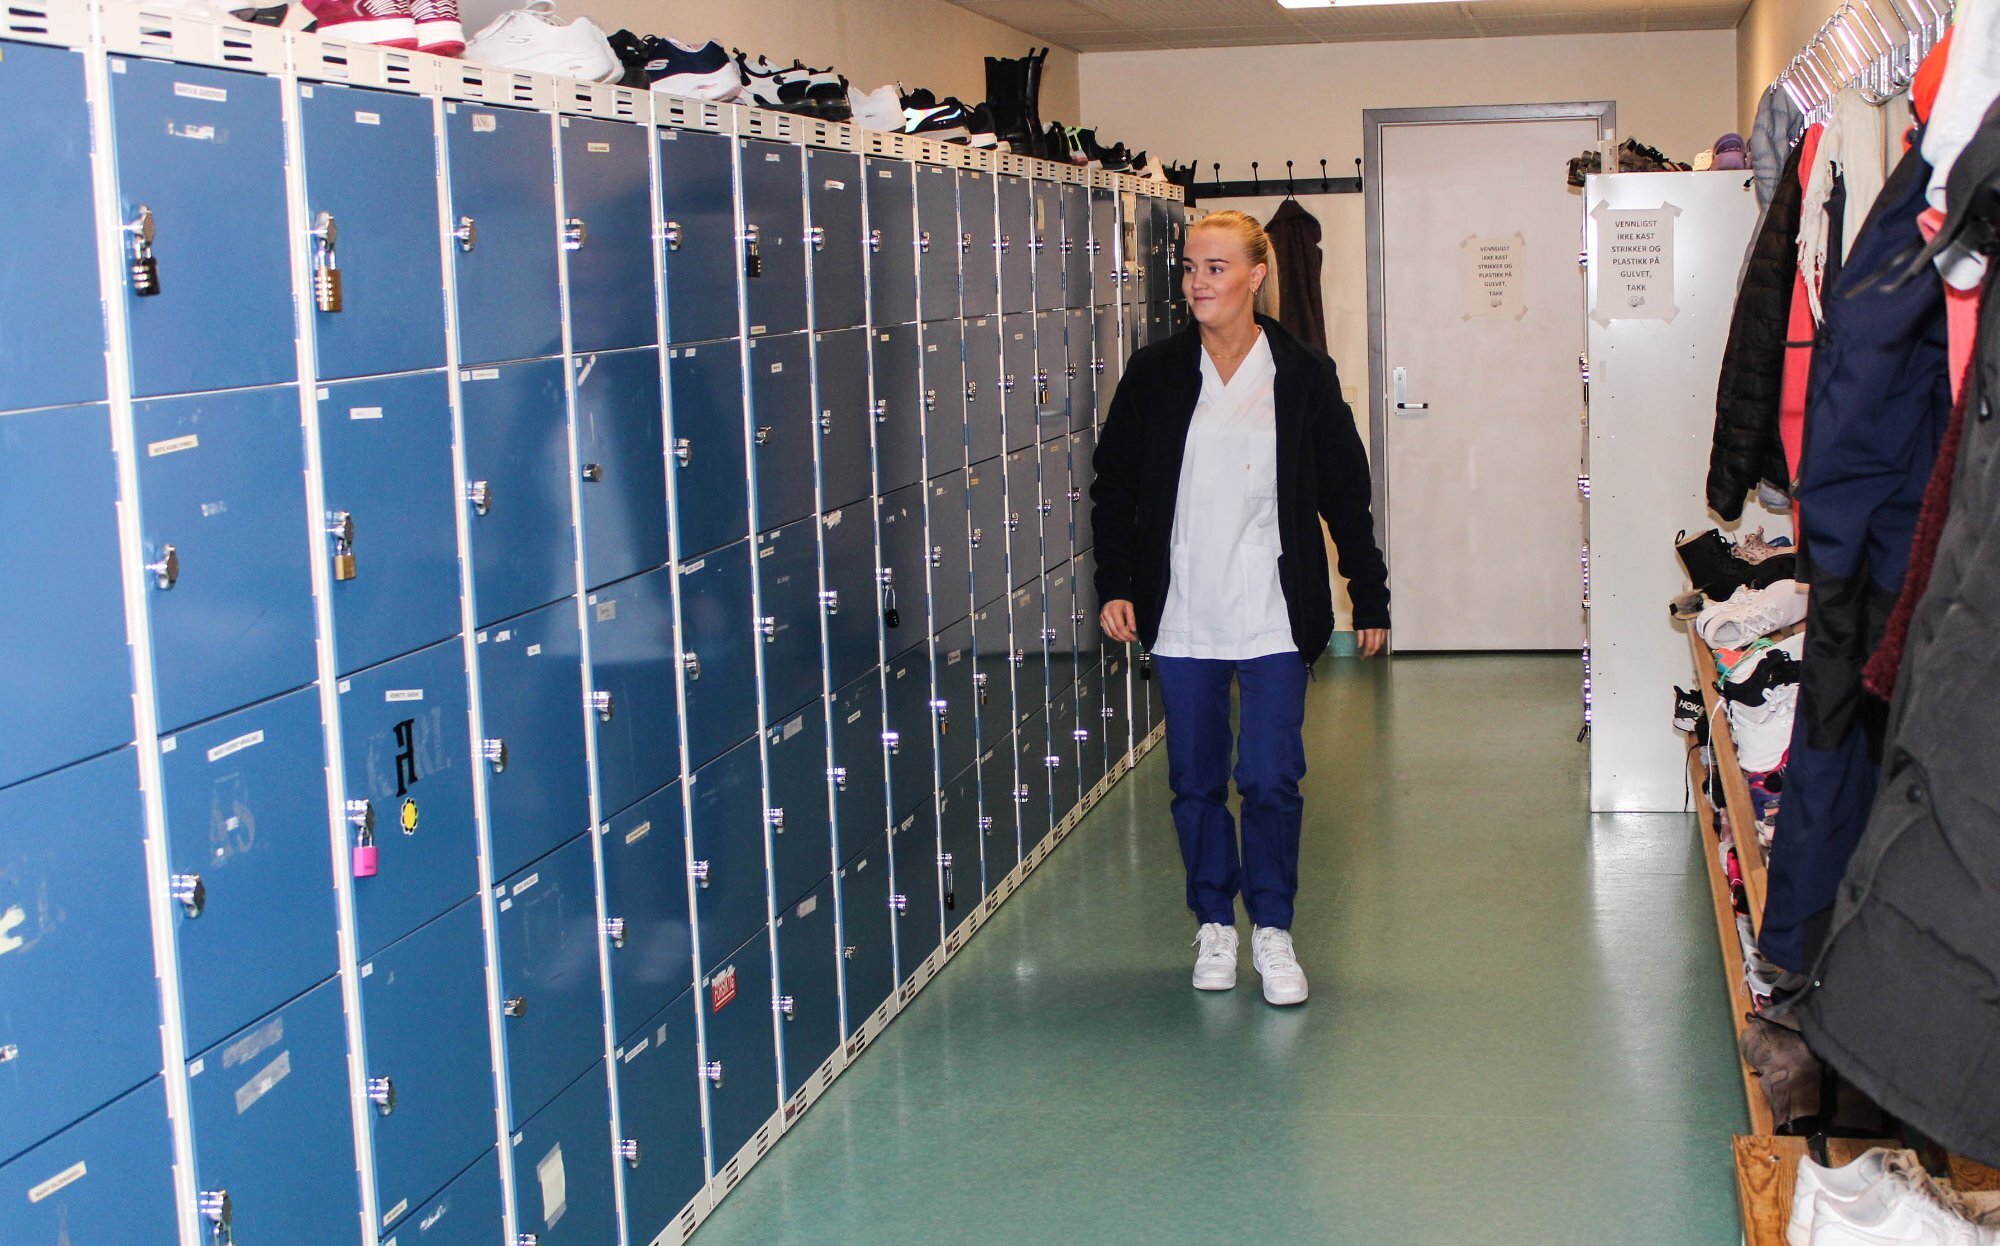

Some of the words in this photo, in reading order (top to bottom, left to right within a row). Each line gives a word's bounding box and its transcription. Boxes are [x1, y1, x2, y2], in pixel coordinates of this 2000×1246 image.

[1614, 220, 1658, 228] VENNLIGST
[1611, 245, 1647, 253] STRIKKER
[1649, 255, 1660, 265] PÅ
[1620, 270, 1653, 278] GULVET,
[1626, 284, 1647, 292] TAKK
